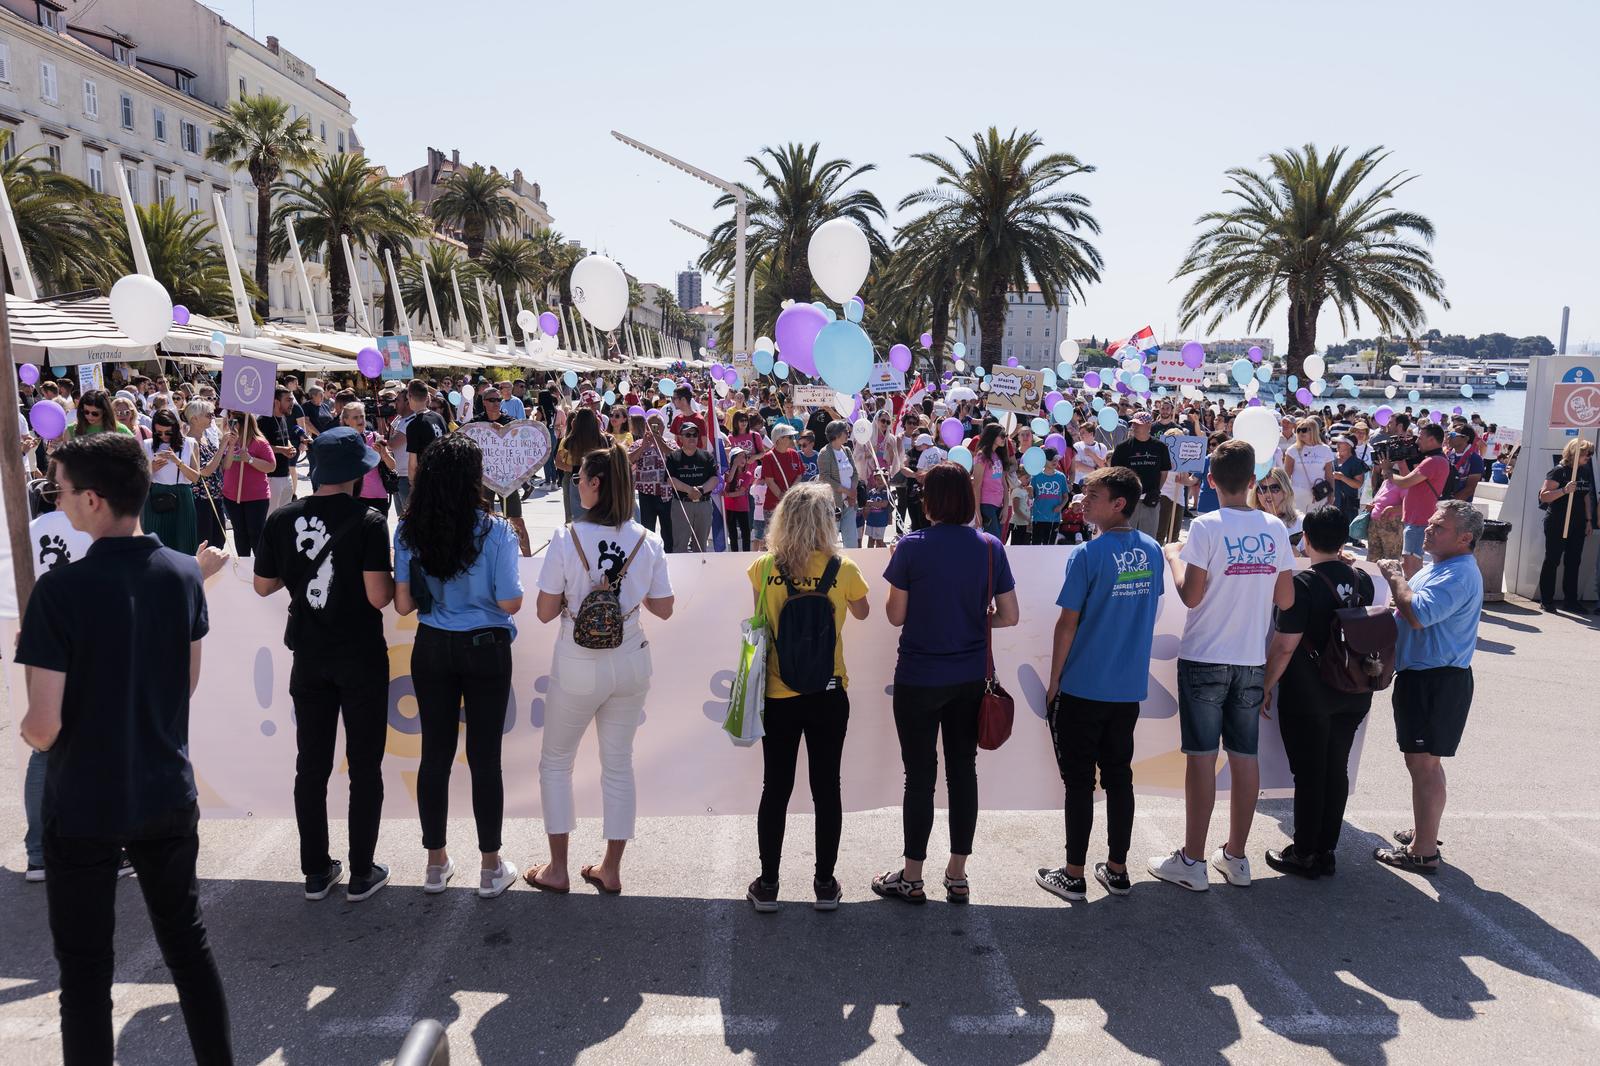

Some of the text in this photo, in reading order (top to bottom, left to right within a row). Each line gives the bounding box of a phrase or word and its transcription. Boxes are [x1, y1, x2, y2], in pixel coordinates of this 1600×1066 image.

[87, 348, 121, 360] Veneranda
[1036, 481, 1060, 490] HOD
[1224, 533, 1276, 556] HOD
[1112, 547, 1147, 567] HOD
[1227, 554, 1277, 565] ZA ŽIVOT
[1118, 566, 1127, 574] ZA
[767, 575, 838, 588] VOONTR
